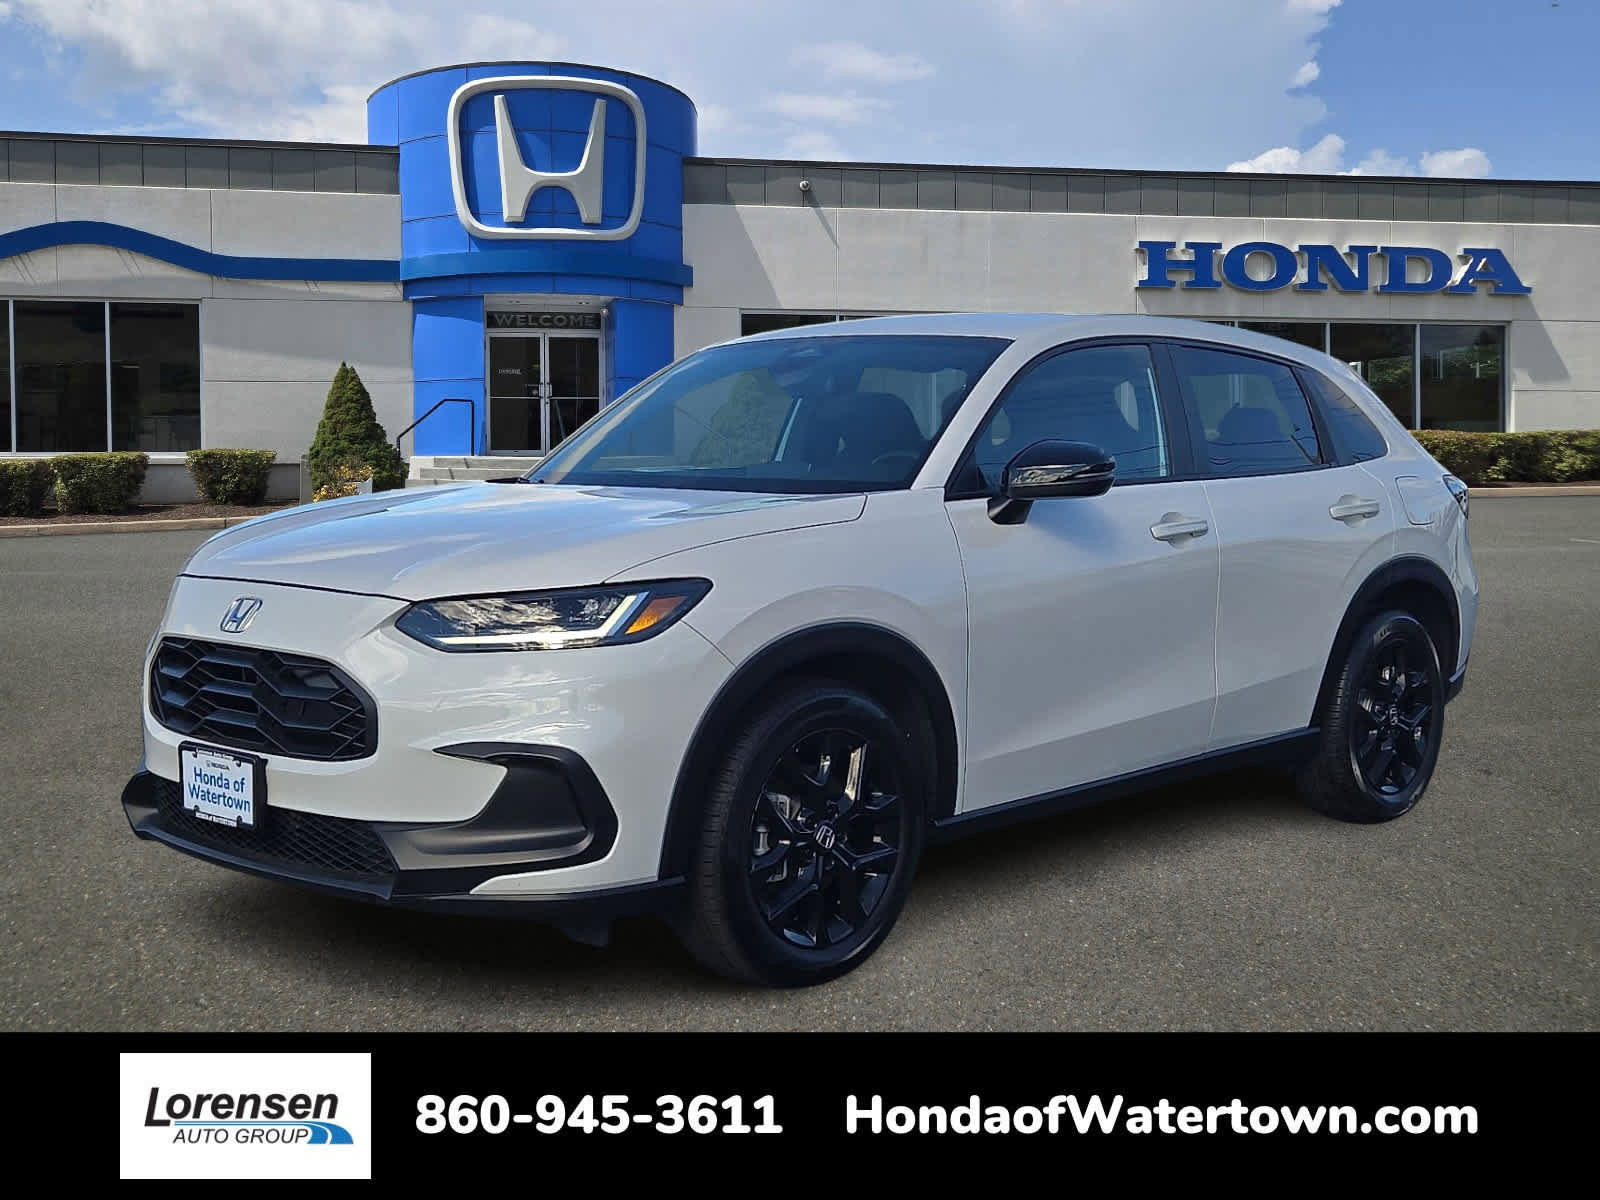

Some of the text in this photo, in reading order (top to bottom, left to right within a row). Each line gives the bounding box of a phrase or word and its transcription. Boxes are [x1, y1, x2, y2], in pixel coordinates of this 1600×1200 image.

[1137, 241, 1532, 295] HONDA
[494, 313, 595, 328] WELCOME
[194, 766, 245, 793] Honda of
[188, 783, 250, 813] Watertown
